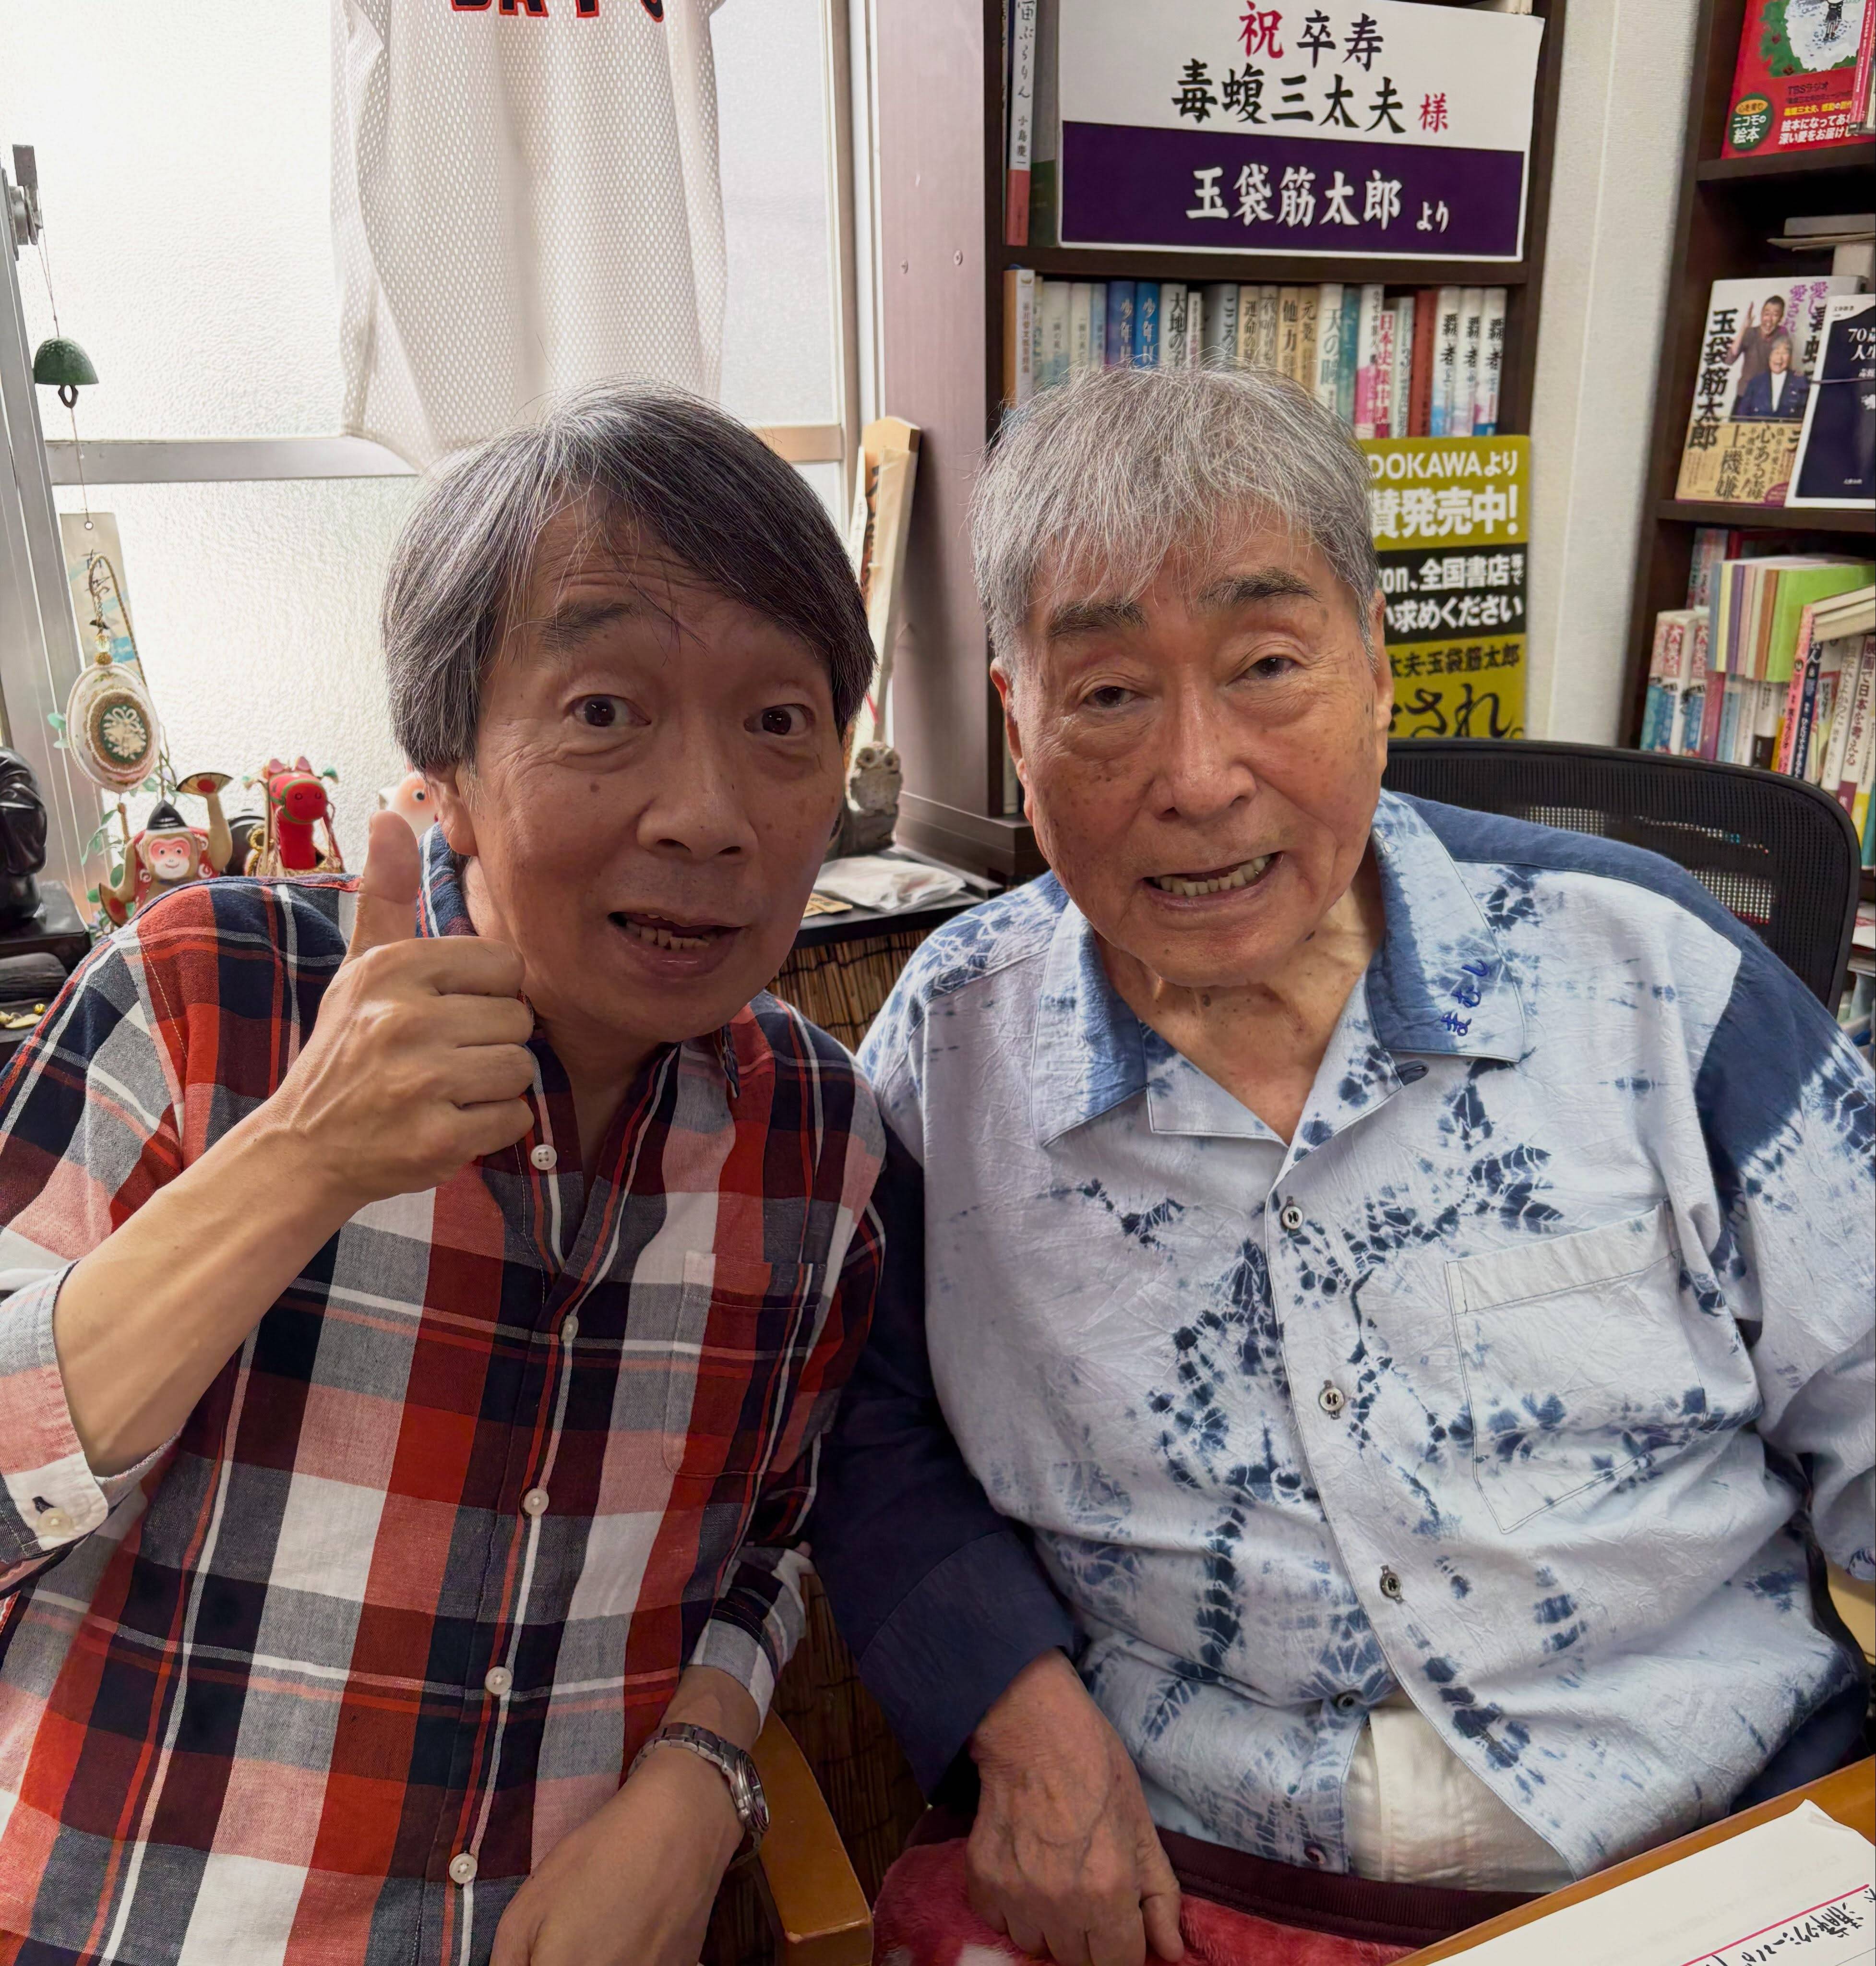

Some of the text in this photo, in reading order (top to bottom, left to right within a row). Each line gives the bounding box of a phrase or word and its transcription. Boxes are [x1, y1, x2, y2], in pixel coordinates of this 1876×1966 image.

[1733, 126, 1760, 144] 絵本
[1687, 308, 1738, 451] 玉袋筋太郎
